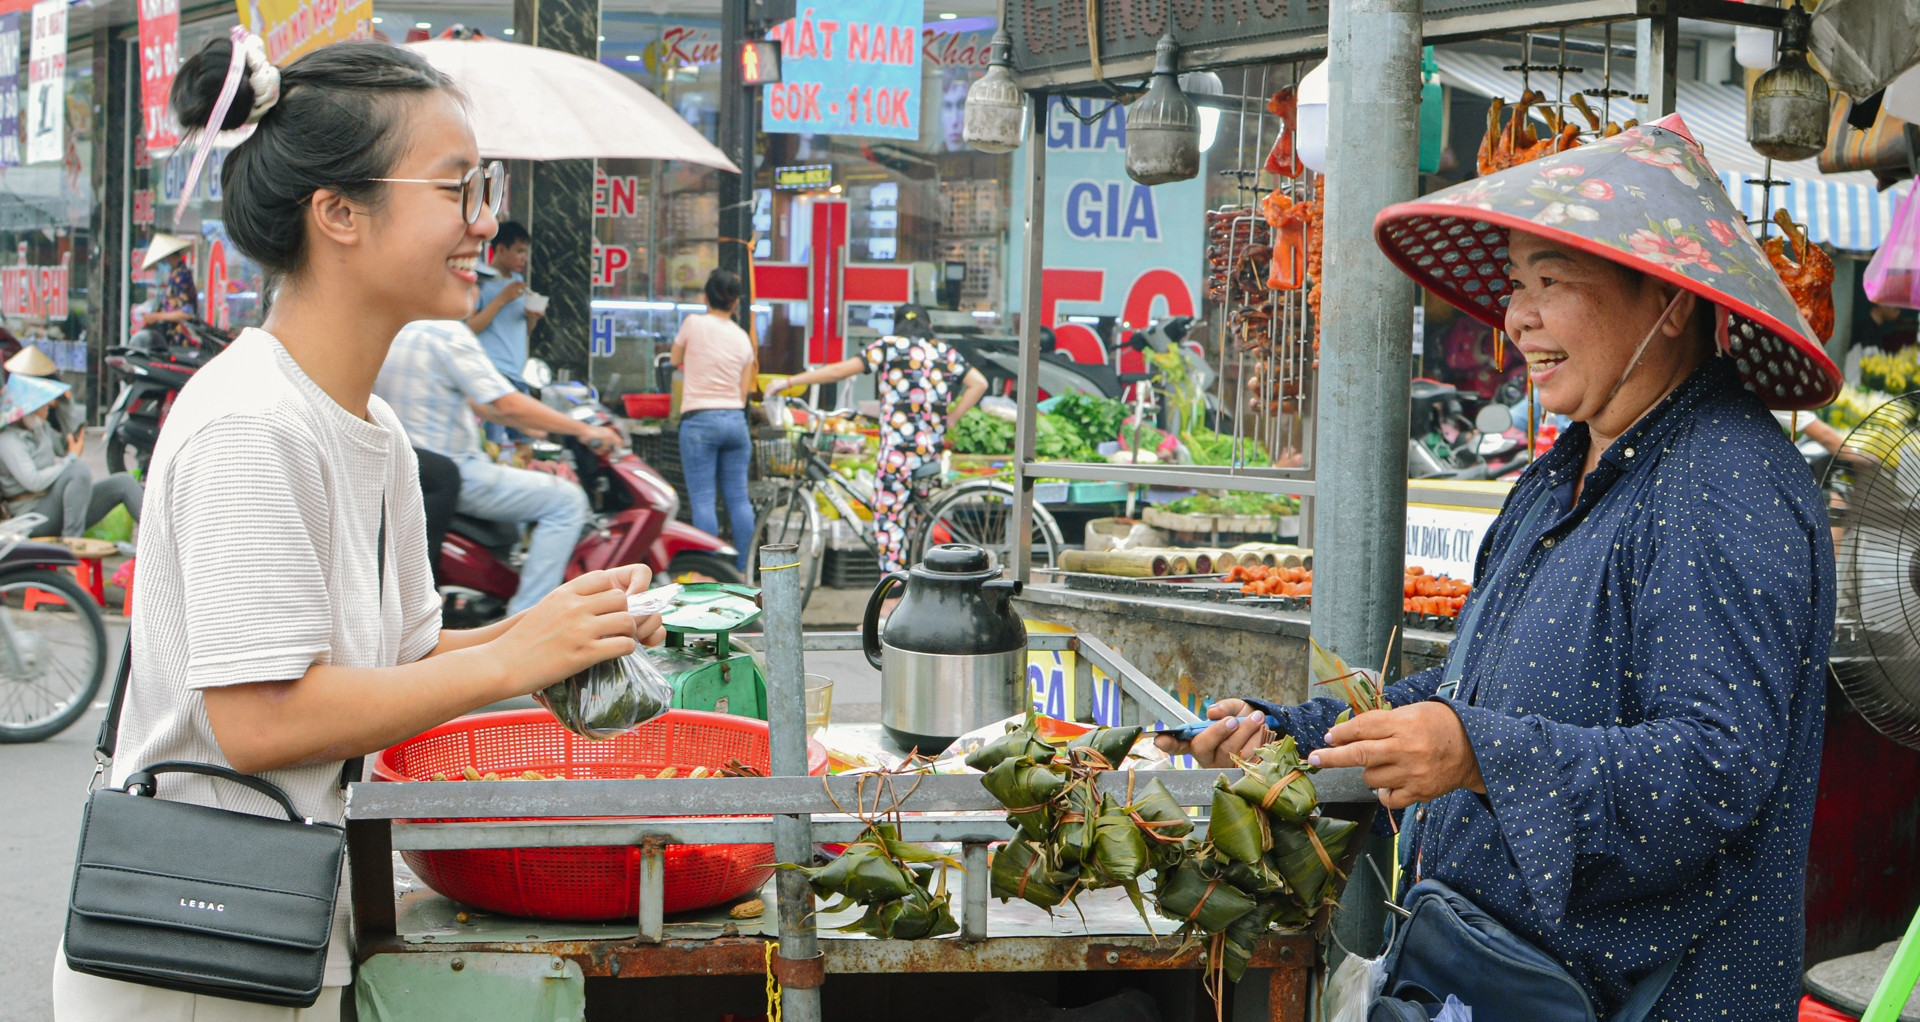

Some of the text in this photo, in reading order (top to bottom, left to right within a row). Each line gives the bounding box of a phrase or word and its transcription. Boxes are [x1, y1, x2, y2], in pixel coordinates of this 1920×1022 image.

[664, 27, 991, 66] Kín Khác
[771, 9, 914, 66] MÁT NAM
[770, 82, 822, 122] 60K
[847, 85, 910, 128] 110K
[1047, 97, 1128, 149] GIA
[180, 898, 224, 911] LESAC
